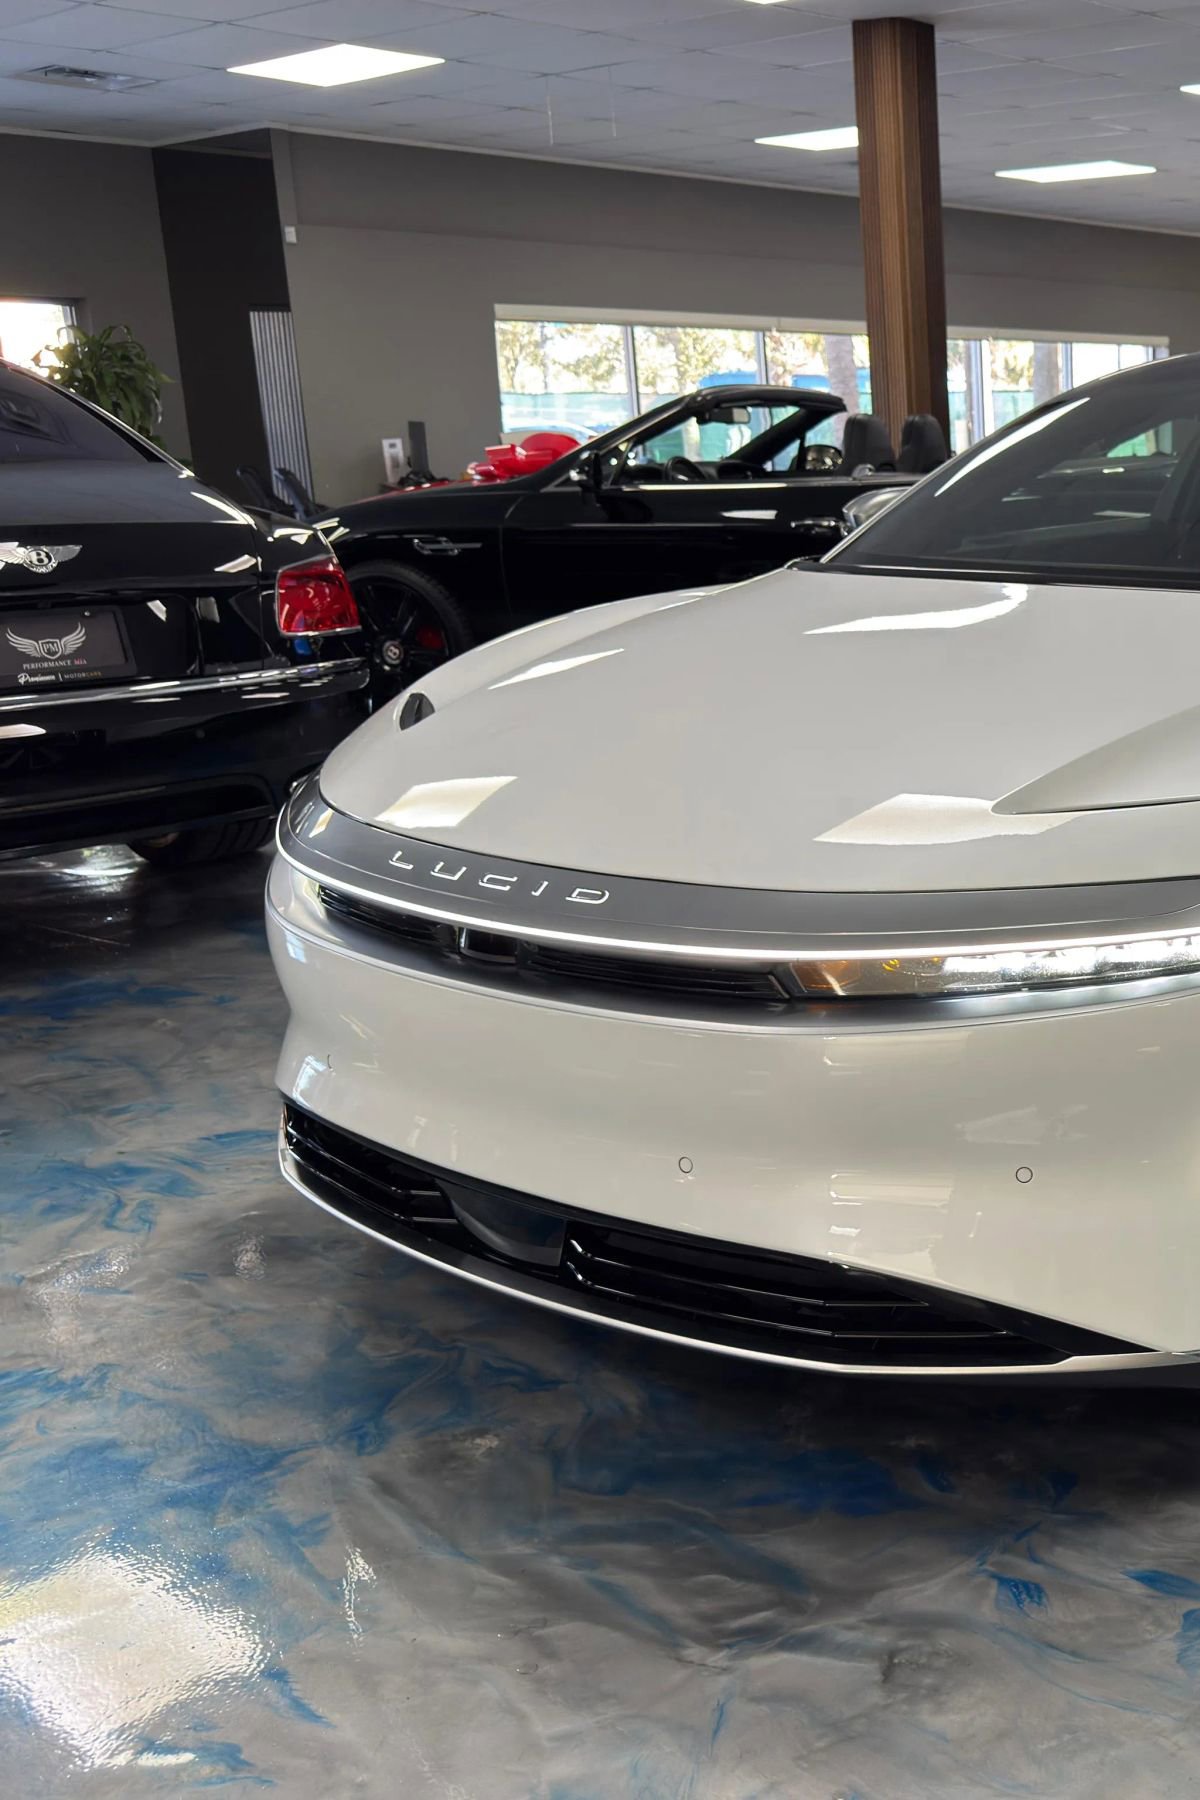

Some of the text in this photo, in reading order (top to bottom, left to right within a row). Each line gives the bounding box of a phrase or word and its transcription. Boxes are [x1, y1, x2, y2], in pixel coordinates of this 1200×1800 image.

[43, 643, 58, 654] PM
[23, 660, 71, 670] PERFORMANCE
[389, 850, 610, 904] LUCID
